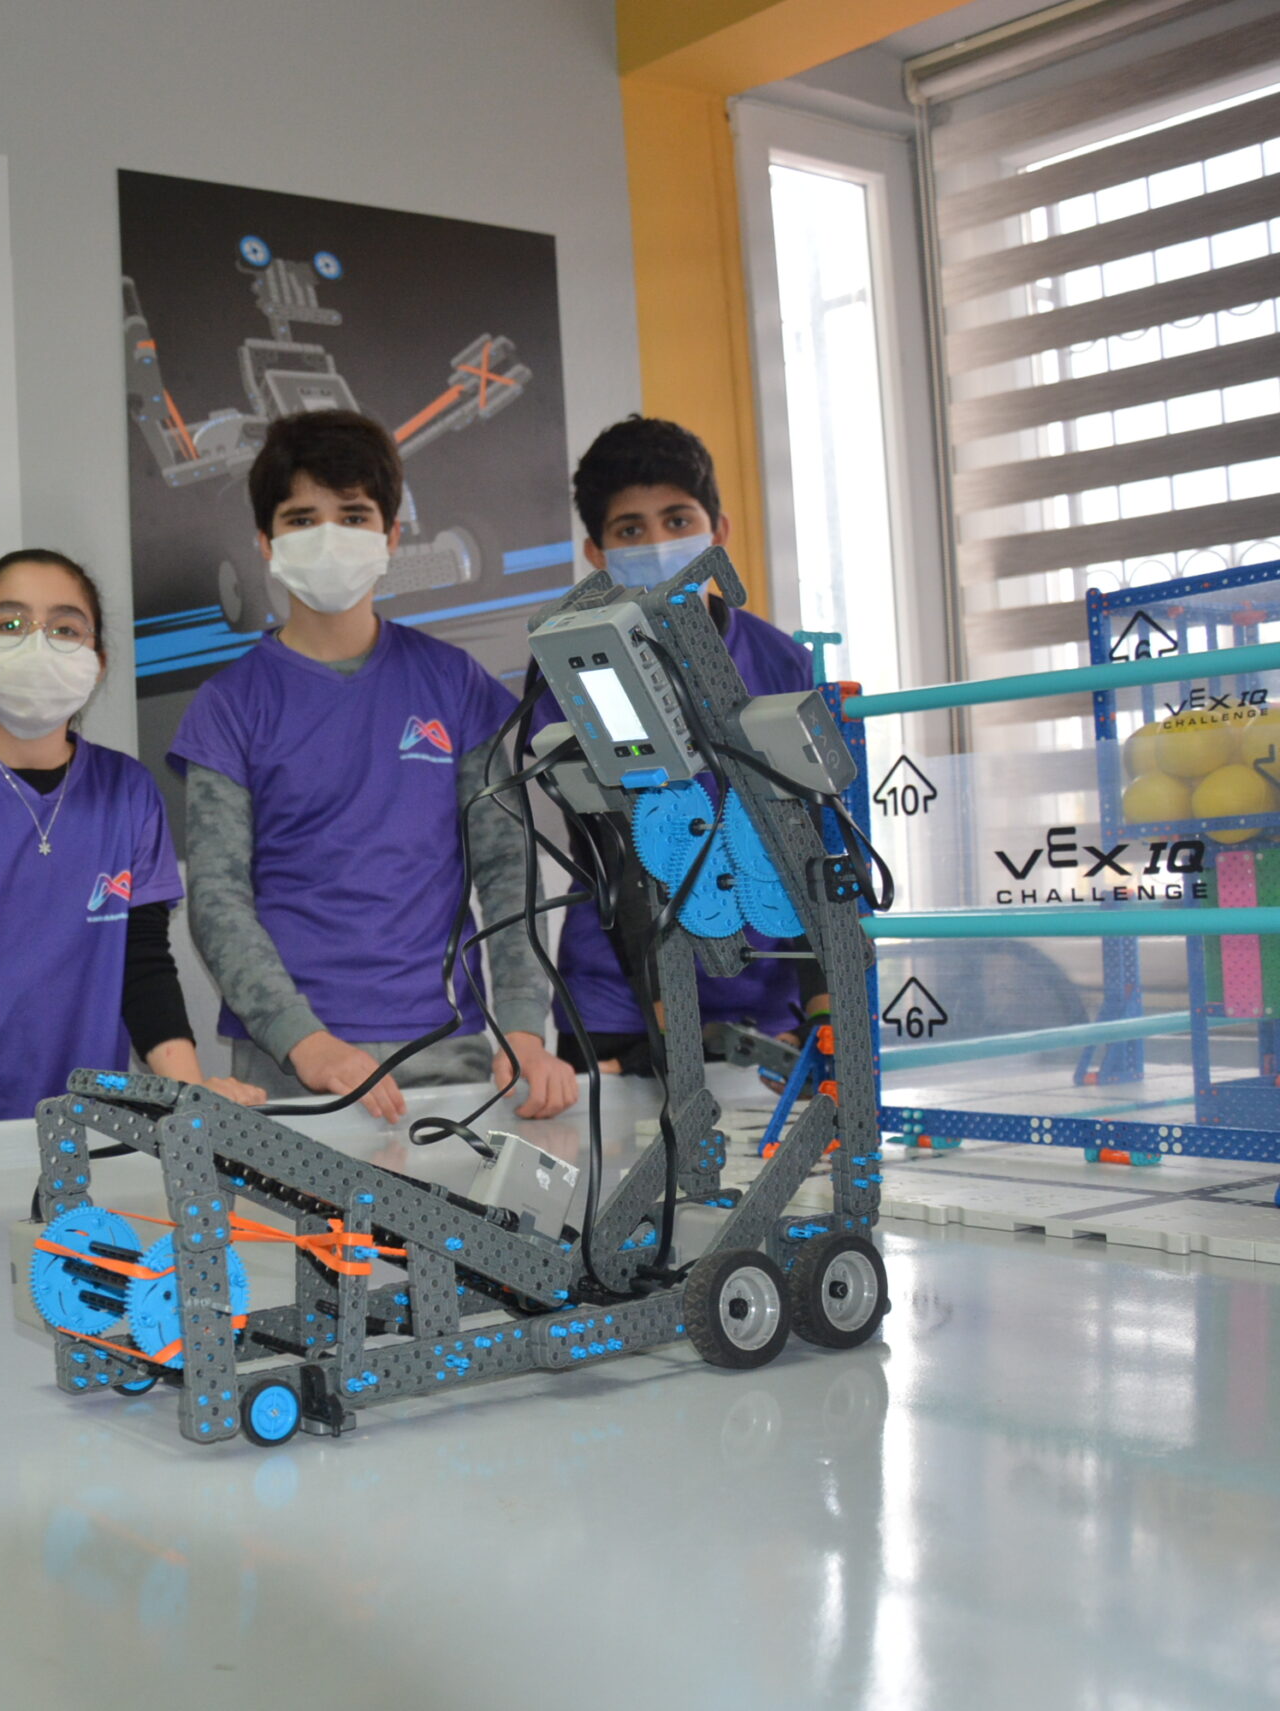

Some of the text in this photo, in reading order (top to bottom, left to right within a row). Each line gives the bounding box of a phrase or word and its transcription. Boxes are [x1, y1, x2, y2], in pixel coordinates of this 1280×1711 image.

[1164, 687, 1269, 717] VEX IQ
[1162, 708, 1269, 730] CHALLENGE
[886, 784, 920, 817] 10
[994, 826, 1206, 881] VEX IQ
[995, 883, 1209, 905] CHALLENGE
[905, 1005, 925, 1039] 6
